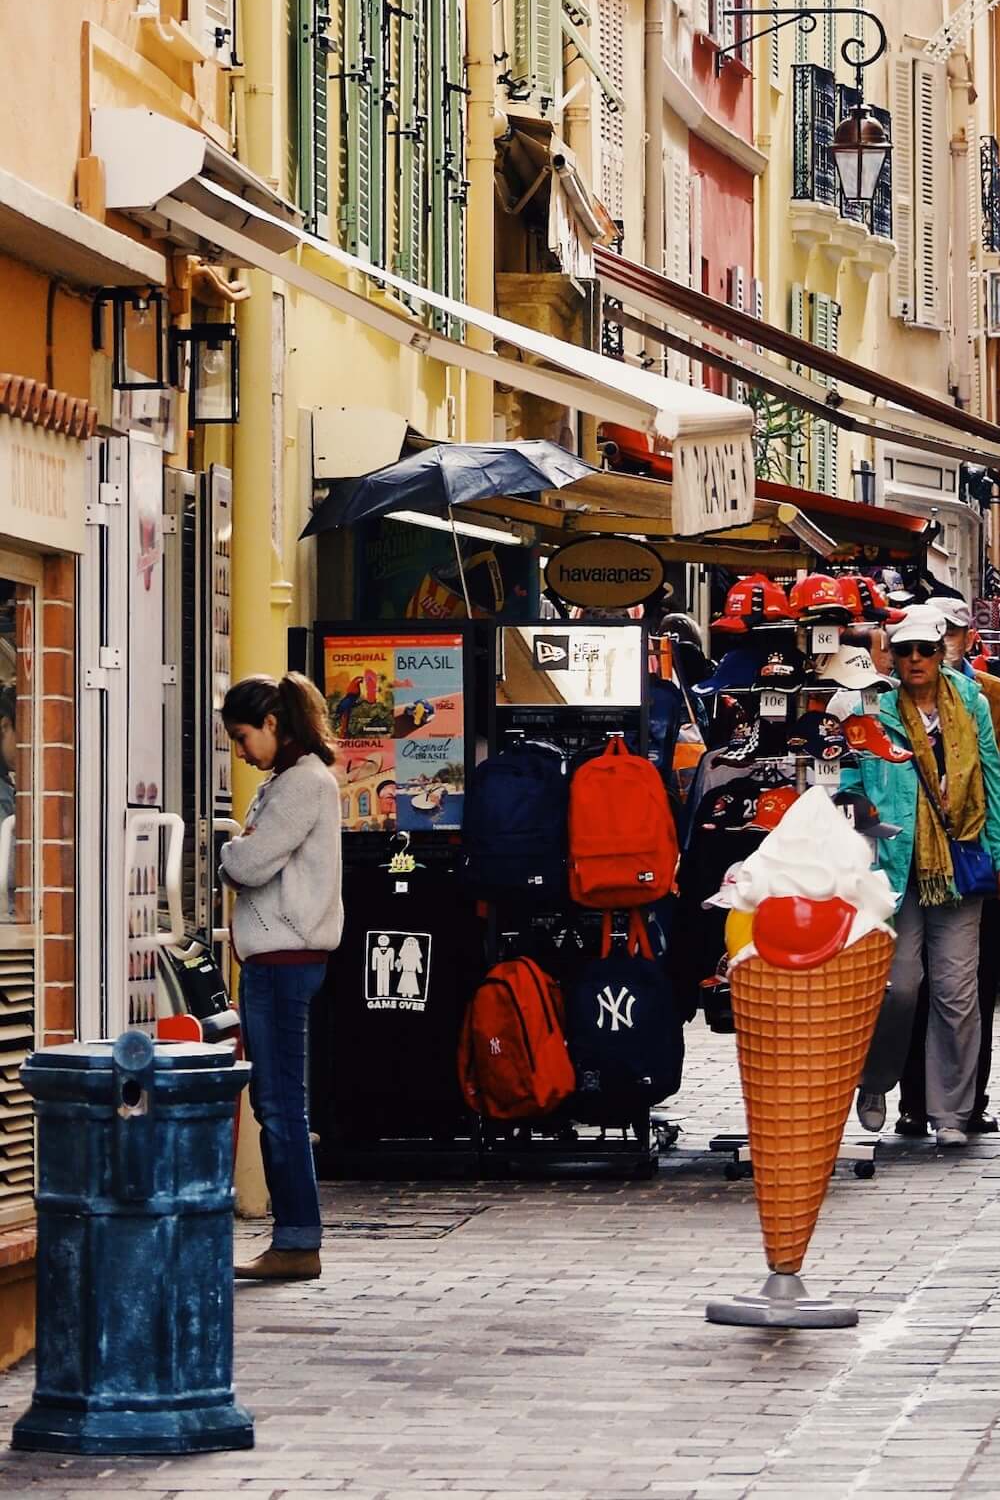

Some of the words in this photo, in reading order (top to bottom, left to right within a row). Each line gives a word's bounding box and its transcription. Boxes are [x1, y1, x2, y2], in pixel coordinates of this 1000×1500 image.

[559, 565, 651, 583] havaianas
[817, 633, 833, 645] 8€
[332, 652, 388, 663] ORIGINAL
[397, 655, 455, 670] BRASIL
[763, 693, 785, 707] 10€
[816, 763, 839, 776] 10€
[366, 1000, 397, 1010] GAME
[399, 1001, 426, 1012] OVER
[596, 985, 636, 1031] NY
